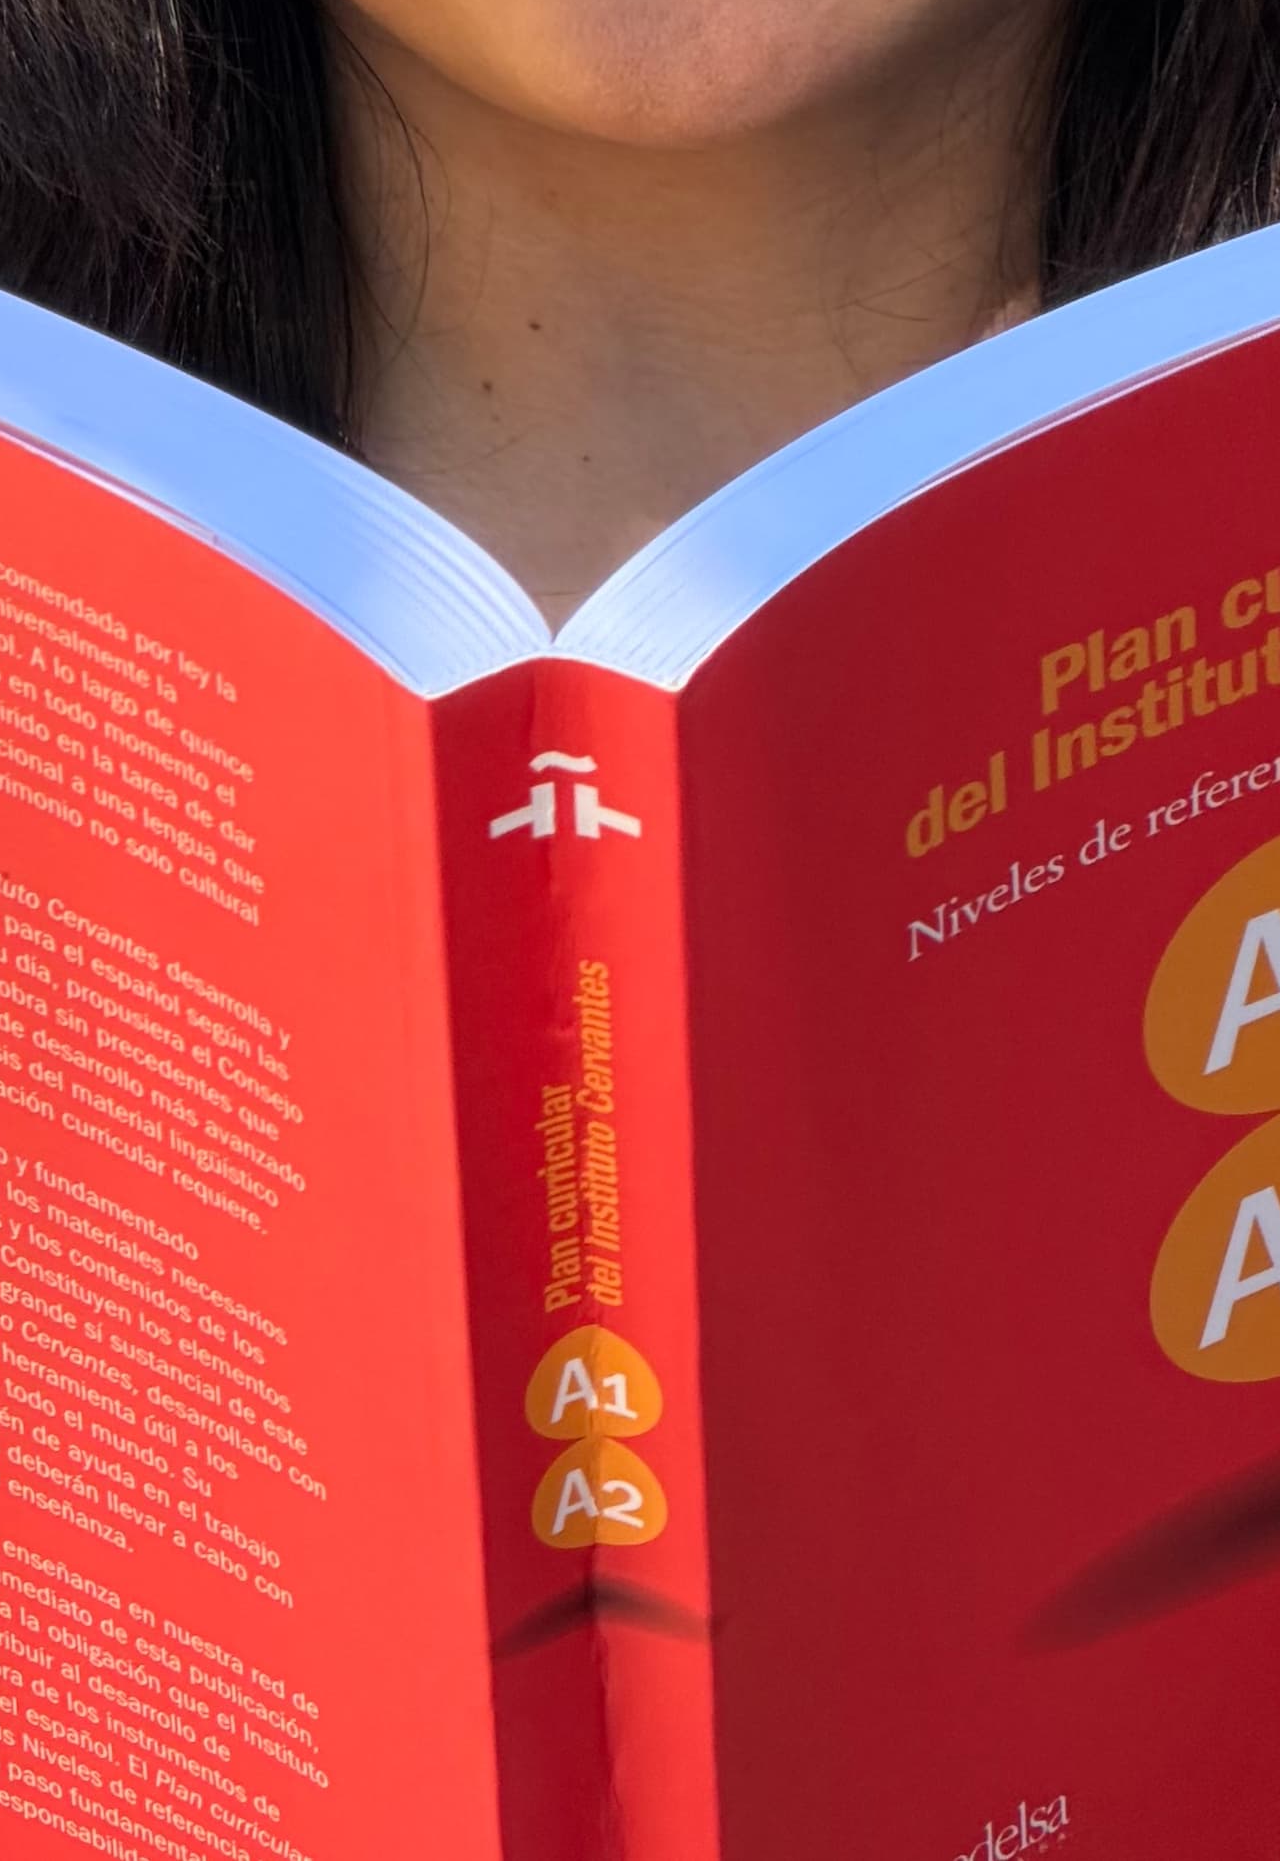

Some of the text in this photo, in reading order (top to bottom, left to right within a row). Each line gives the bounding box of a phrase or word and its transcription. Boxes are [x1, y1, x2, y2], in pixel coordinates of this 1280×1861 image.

[134, 632, 172, 664] por
[177, 650, 210, 690] ley
[215, 673, 237, 703] la
[156, 675, 177, 703] la
[1041, 608, 1196, 714] Plan
[71, 775, 86, 795] a
[93, 786, 136, 821] una
[142, 807, 217, 866] lengua
[223, 858, 264, 895] que
[906, 753, 1006, 857] del
[90, 819, 120, 847] no
[125, 837, 174, 875] solo
[179, 867, 259, 927] cultural
[909, 855, 1064, 961] Niveles
[1079, 820, 1130, 865] de
[4, 915, 56, 953] para
[63, 944, 84, 967] el
[90, 958, 180, 1016] español
[186, 1008, 251, 1058] según
[257, 1044, 290, 1081] las
[47, 898, 160, 971] Cervantes
[165, 961, 273, 1037] desarrolla
[279, 1028, 291, 1051] y
[61, 1112, 166, 1177] curricular
[172, 1168, 267, 1235] requiere.
[572, 959, 623, 1307] del Instituto Cervantes
[15, 1156, 28, 1178] y
[34, 1161, 199, 1261] fundamentado
[535, 1085, 582, 1313] Plan curricular
[6, 1180, 41, 1214] los
[47, 1204, 165, 1276] materiales
[171, 1267, 288, 1346] necesarios
[0, 1244, 132, 1325] Constituyen
[139, 1311, 172, 1346] los
[178, 1337, 291, 1414] elementos
[21, 1320, 139, 1396] Cervantes,
[146, 1385, 283, 1473] desarrollado
[287, 1466, 327, 1501] con
[551, 1358, 639, 1423] A1
[7, 1479, 134, 1553] enseñanza.
[552, 1468, 645, 1535] A2
[2, 1540, 121, 1610] enseñanza
[128, 1602, 156, 1628] en
[163, 1619, 244, 1676] nuestra
[250, 1668, 286, 1700] red
[291, 1692, 319, 1720] de
[99, 1618, 128, 1645] de
[135, 1637, 182, 1673] esta
[7, 1761, 63, 1799] paso
[30, 1678, 60, 1704] de
[66, 1691, 100, 1724] los
[106, 1711, 248, 1803] instrumentos
[253, 1795, 281, 1823] de
[953, 1795, 1070, 1861] delsa
